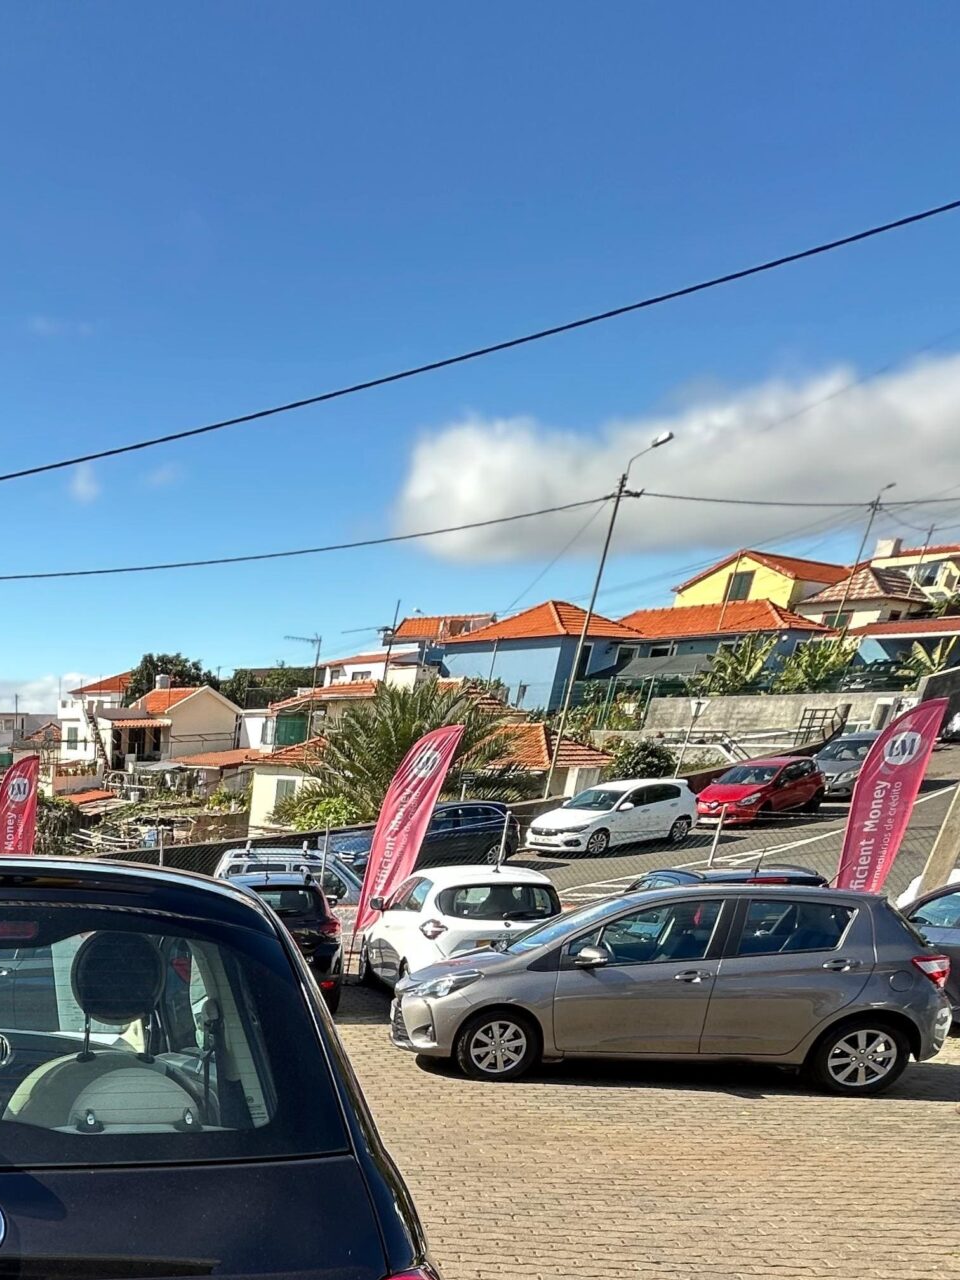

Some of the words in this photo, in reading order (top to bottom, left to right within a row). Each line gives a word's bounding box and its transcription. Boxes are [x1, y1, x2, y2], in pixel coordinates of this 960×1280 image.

[4, 811, 17, 851] Money
[849, 838, 875, 890] ficient
[863, 780, 891, 832] Money
[868, 832, 891, 892] termediários
[882, 818, 894, 831] de
[888, 781, 903, 816] crédito
